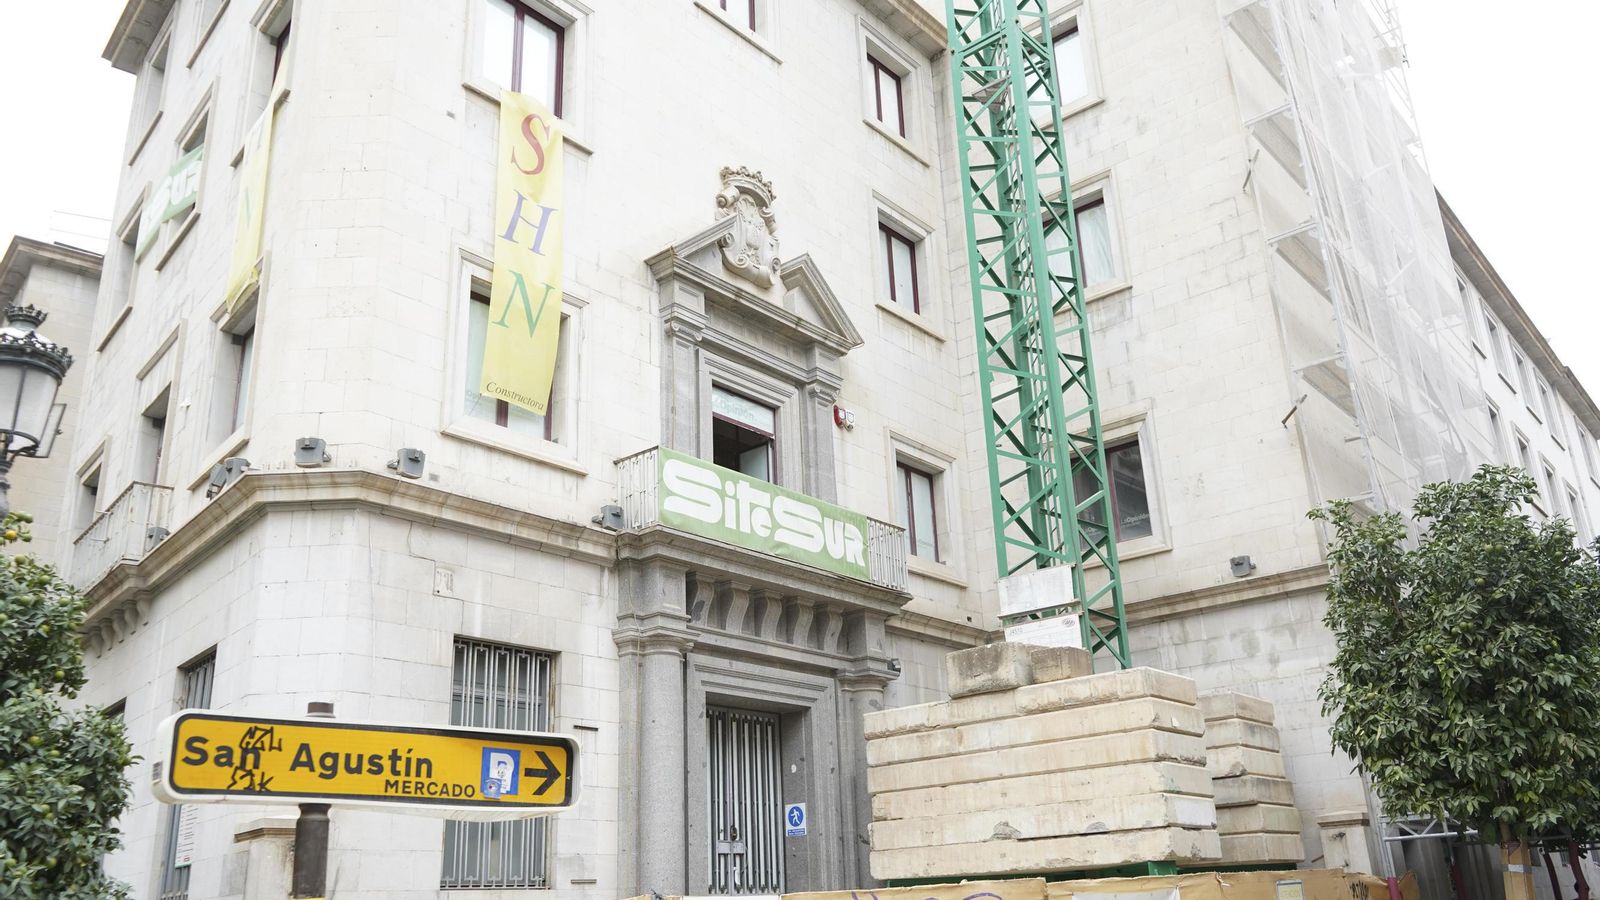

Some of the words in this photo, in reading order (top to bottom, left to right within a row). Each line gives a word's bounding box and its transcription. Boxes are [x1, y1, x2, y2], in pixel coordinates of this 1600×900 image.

[486, 381, 544, 411] Constructora
[182, 735, 261, 770] San
[289, 743, 433, 780] Agustín
[384, 779, 475, 798] MERCADO
